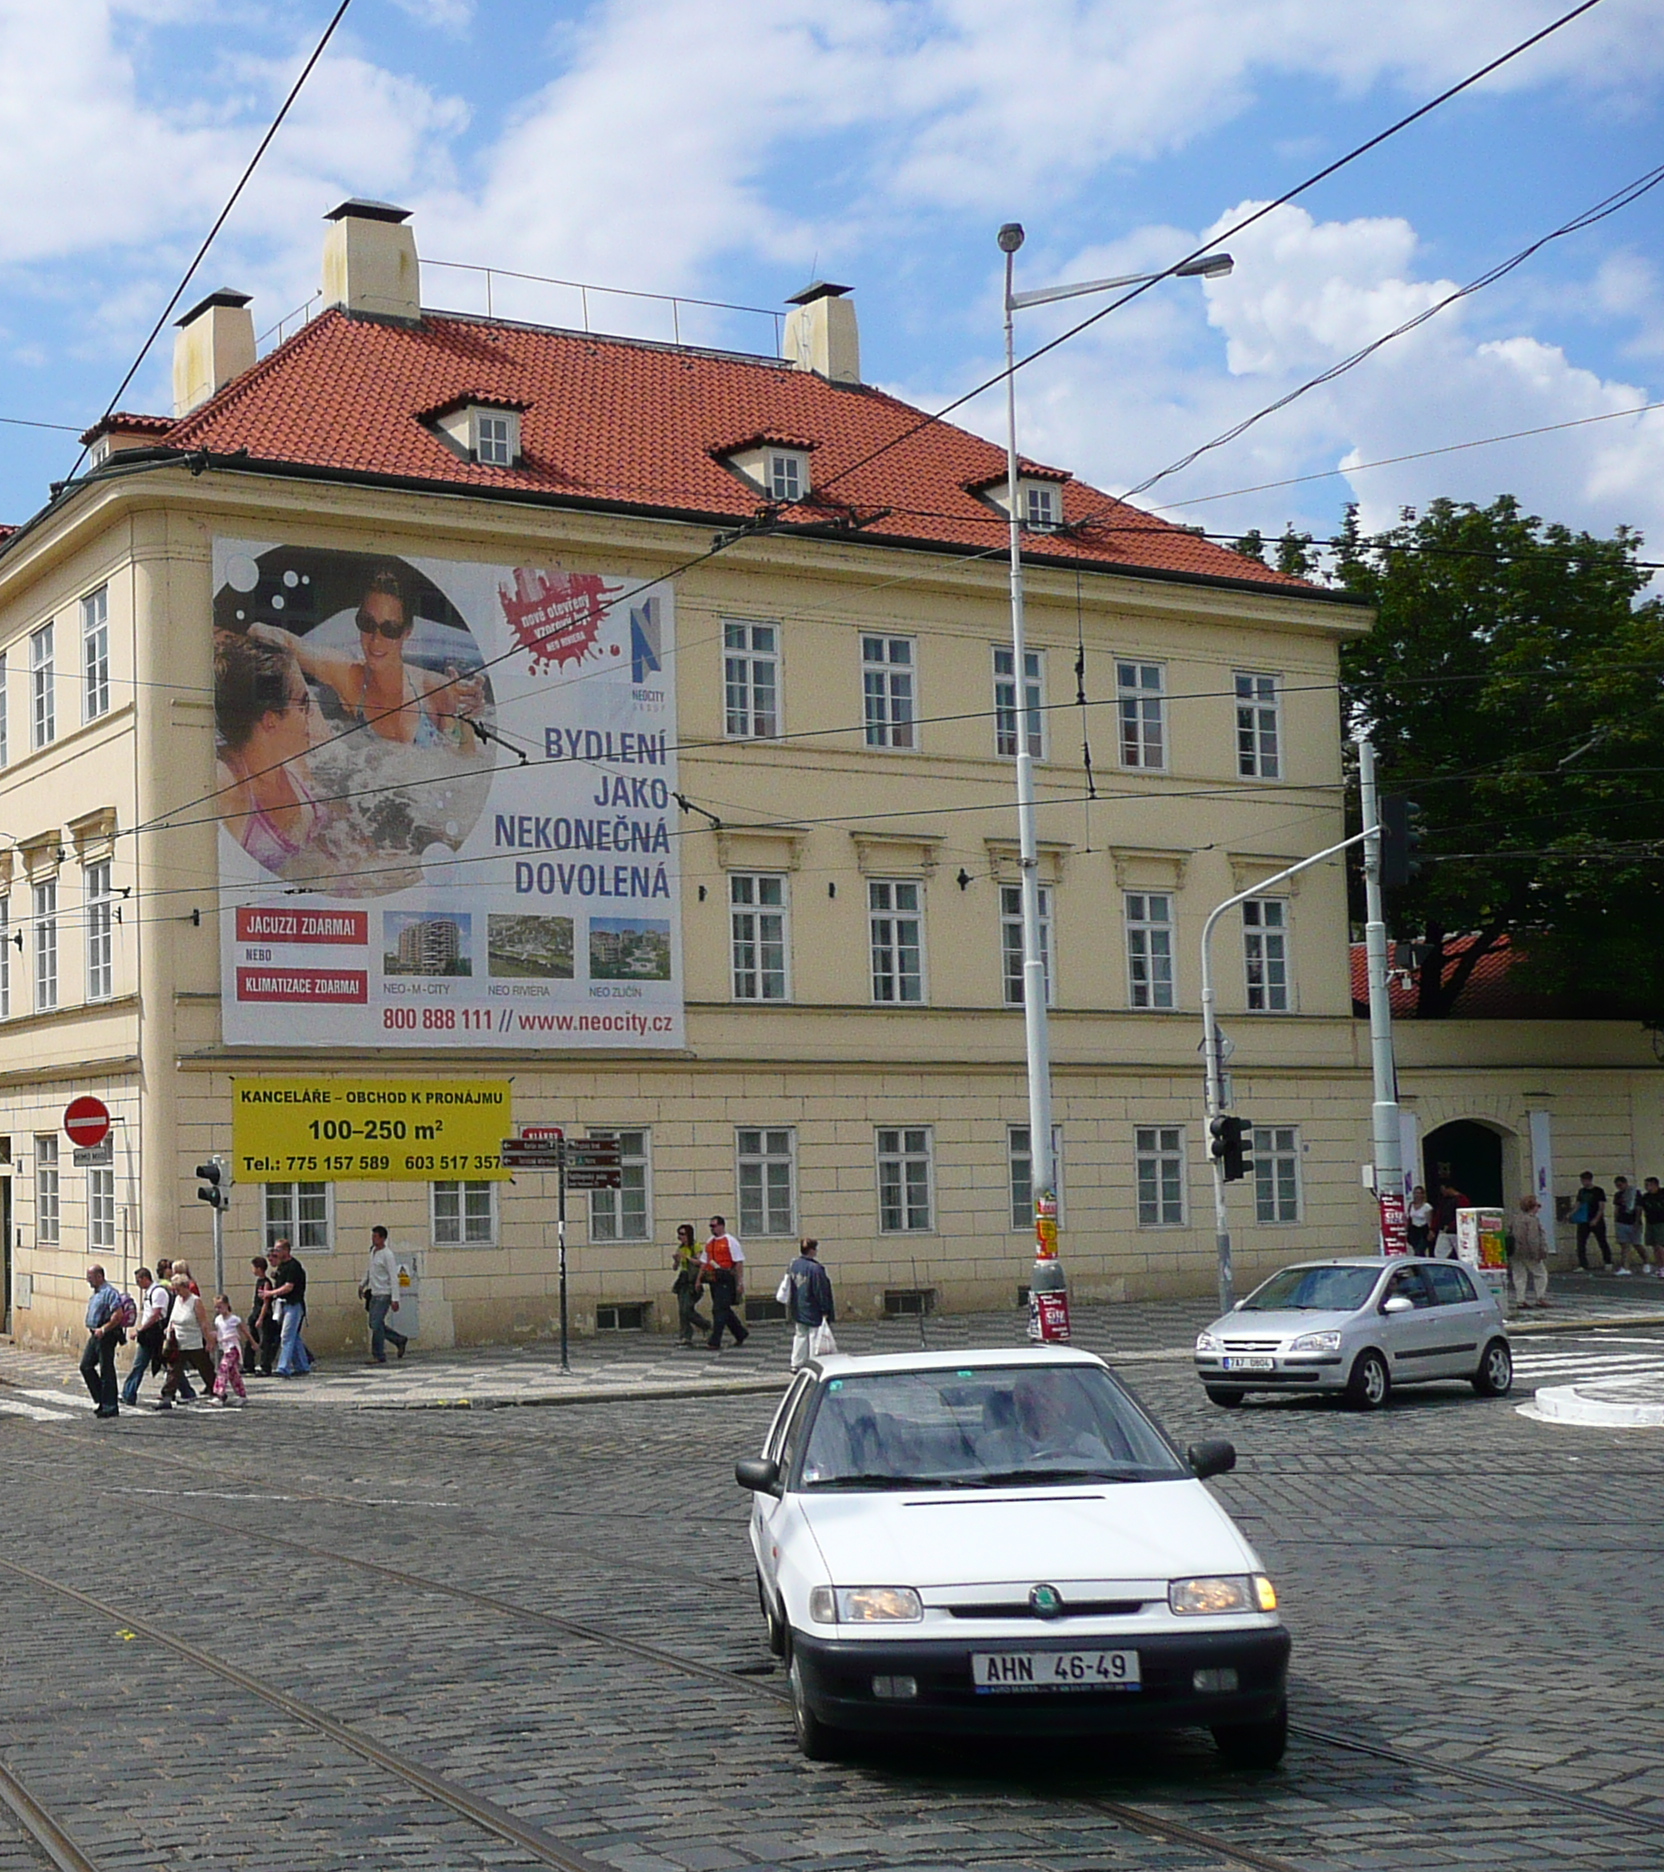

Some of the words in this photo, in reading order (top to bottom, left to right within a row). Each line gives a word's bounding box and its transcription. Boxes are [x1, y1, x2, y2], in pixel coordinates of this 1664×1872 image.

[632, 689, 665, 703] NEOCITY
[544, 727, 667, 766] BYDLENÍ
[593, 776, 669, 809] JAKO
[495, 814, 671, 854] NEKONEČNÁ
[515, 861, 671, 899] DOVOLENÁ
[247, 916, 297, 935] JACUZZI
[301, 917, 356, 936] ZDARMA!
[246, 948, 272, 962] NEBO
[246, 977, 311, 993] KLIMATIZACE
[315, 979, 359, 995] ZDARMA!
[488, 984, 510, 996] NEO
[512, 985, 550, 997] RIVIERA
[589, 986, 610, 998] NEO
[383, 1008, 417, 1029] 800
[423, 1008, 456, 1030] 888
[462, 1008, 492, 1030] 111
[518, 1010, 673, 1036] www.neocity.cz
[241, 1087, 331, 1104] KANCELÁŘE
[346, 1091, 407, 1104] OBCHOD
[411, 1091, 422, 1104] K
[426, 1088, 503, 1105] PRONÁJMU
[243, 1156, 281, 1171] Tel.:
[286, 1156, 318, 1170] 775
[324, 1156, 354, 1170] 157
[359, 1156, 390, 1170] 589
[405, 1156, 435, 1170] 603
[440, 1155, 469, 1170] 517
[474, 1155, 501, 1170] 357
[987, 1656, 1034, 1682] AHN
[1054, 1654, 1126, 1680] 46-49
